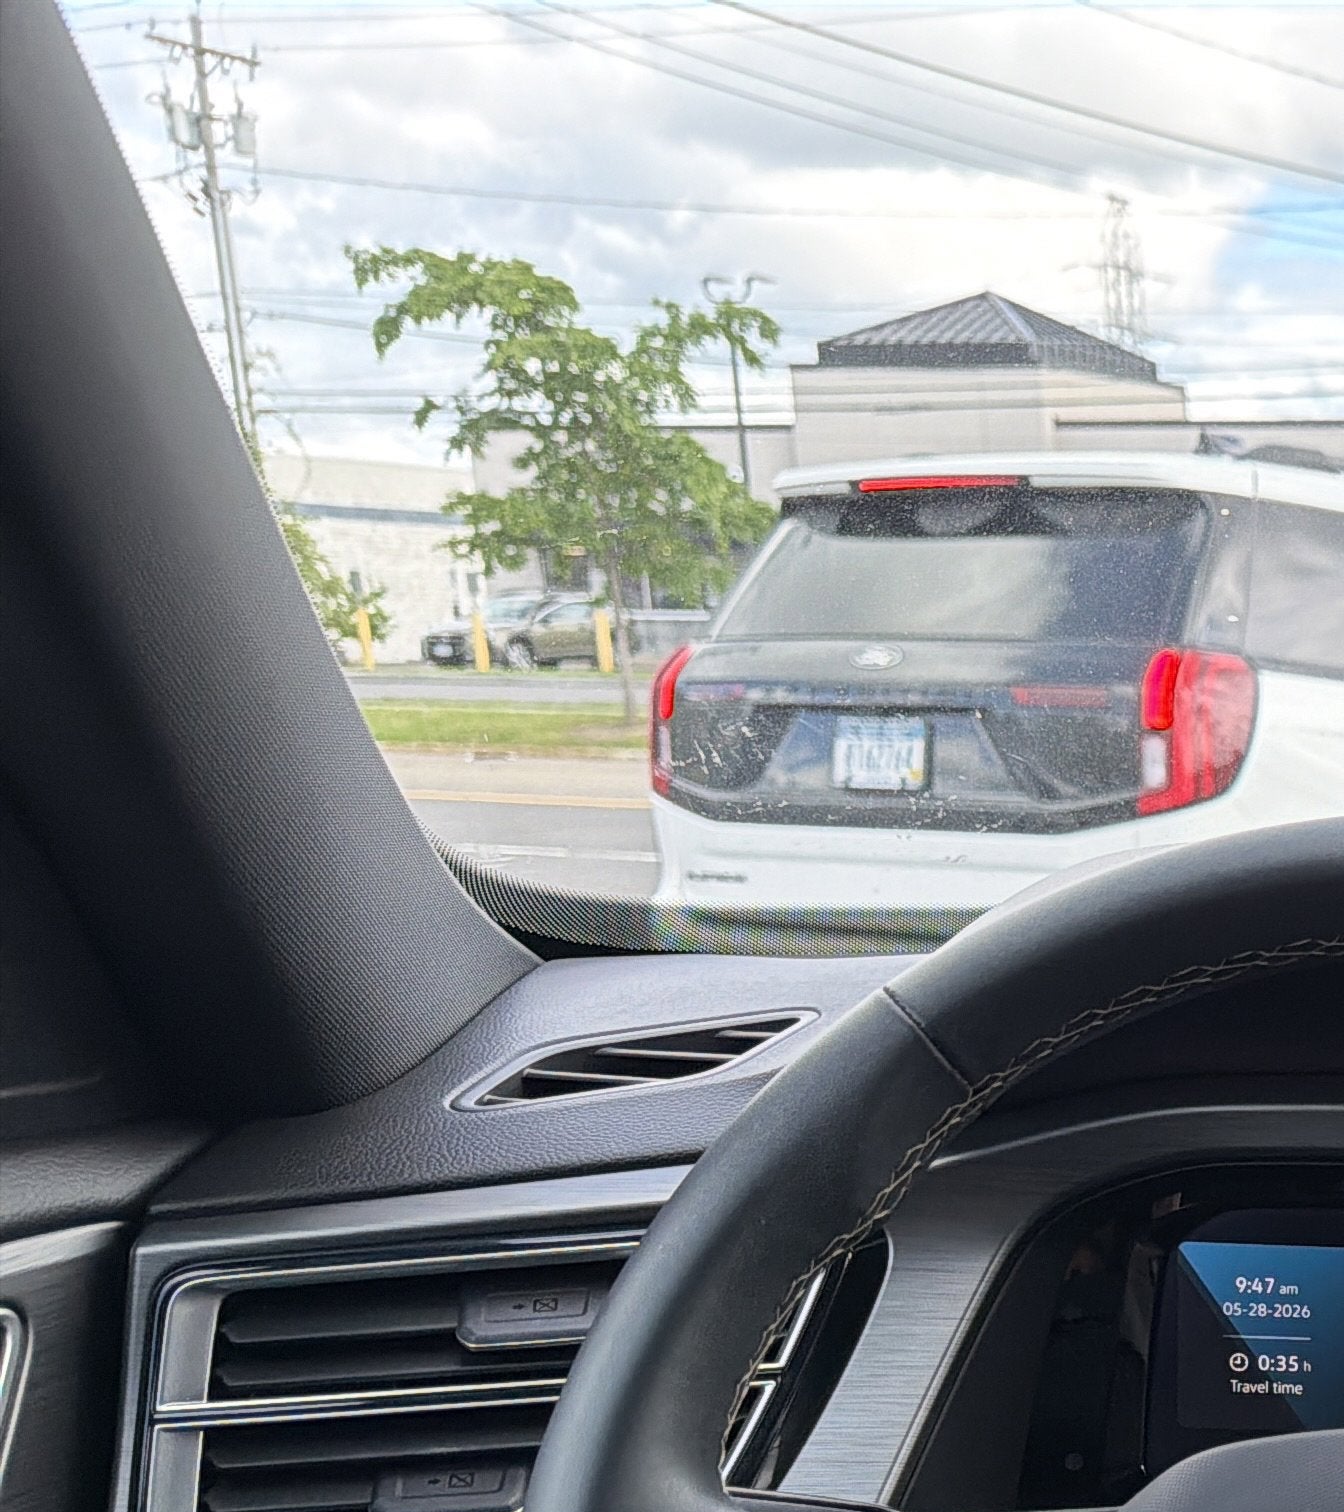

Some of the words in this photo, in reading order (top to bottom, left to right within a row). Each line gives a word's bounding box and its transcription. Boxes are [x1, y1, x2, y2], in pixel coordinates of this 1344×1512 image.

[1236, 1277, 1274, 1293] 9:47
[1279, 1285, 1298, 1294] am
[1223, 1302, 1310, 1318] 05-28-2026
[1258, 1355, 1298, 1371] 0:35
[1304, 1361, 1311, 1371] h
[1229, 1380, 1268, 1394] Travel
[1273, 1382, 1303, 1395] time
